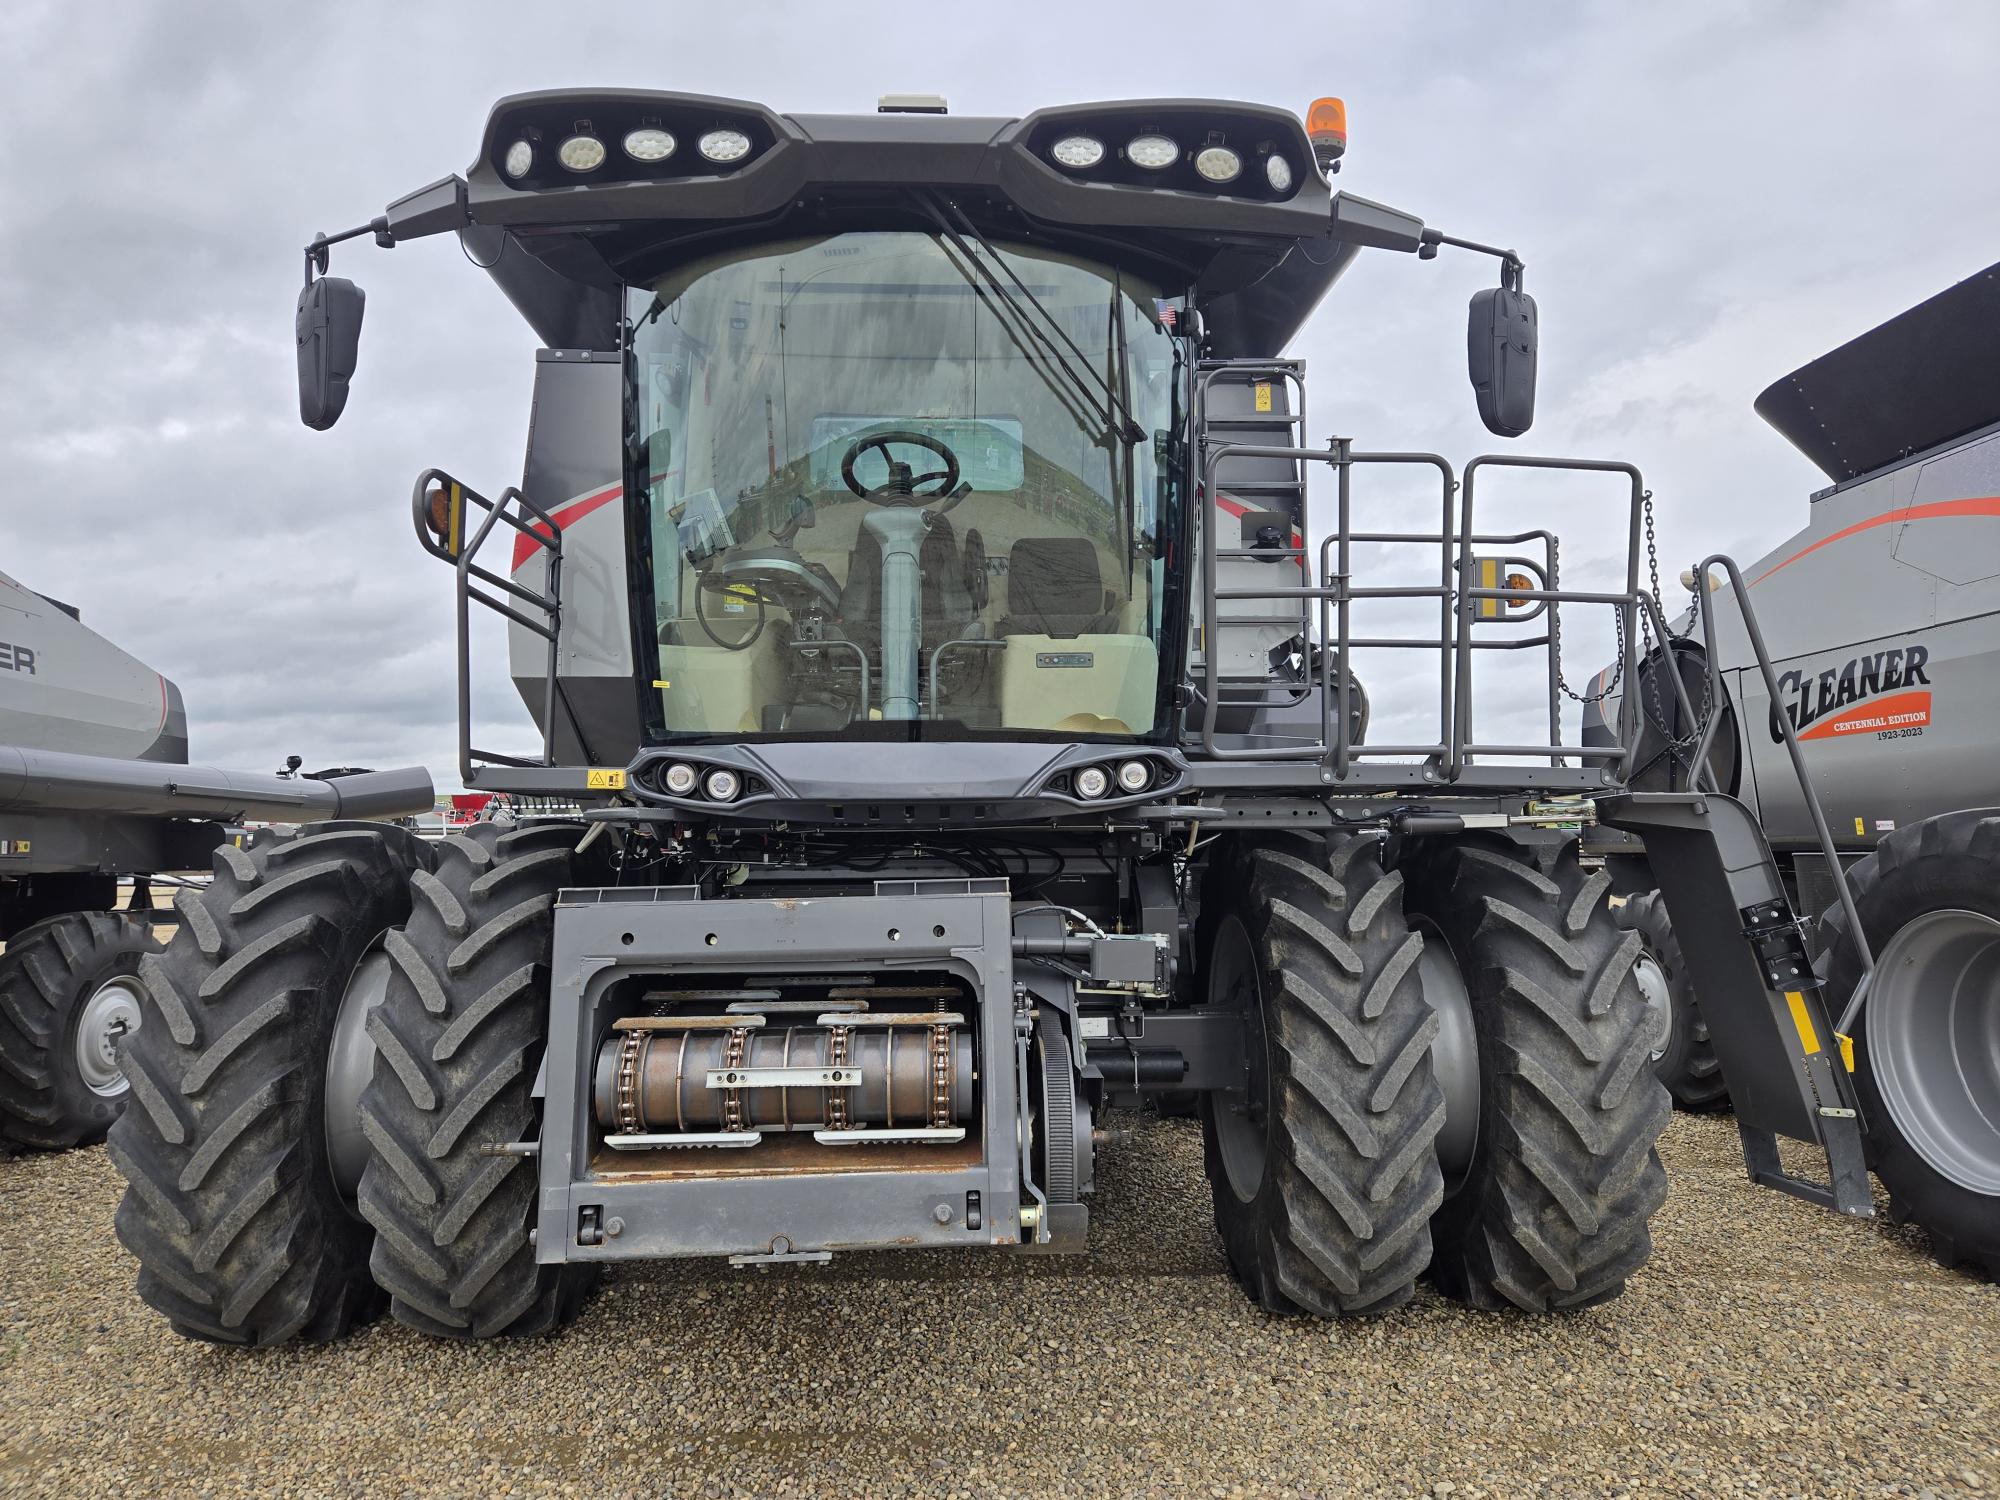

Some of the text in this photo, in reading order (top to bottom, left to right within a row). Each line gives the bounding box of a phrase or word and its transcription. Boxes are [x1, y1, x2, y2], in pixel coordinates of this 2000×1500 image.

[1768, 645, 1931, 745] GLEANER
[1833, 711, 1927, 732] CENTENNIAL EDITION
[1876, 727, 1924, 741] 1923-2023
